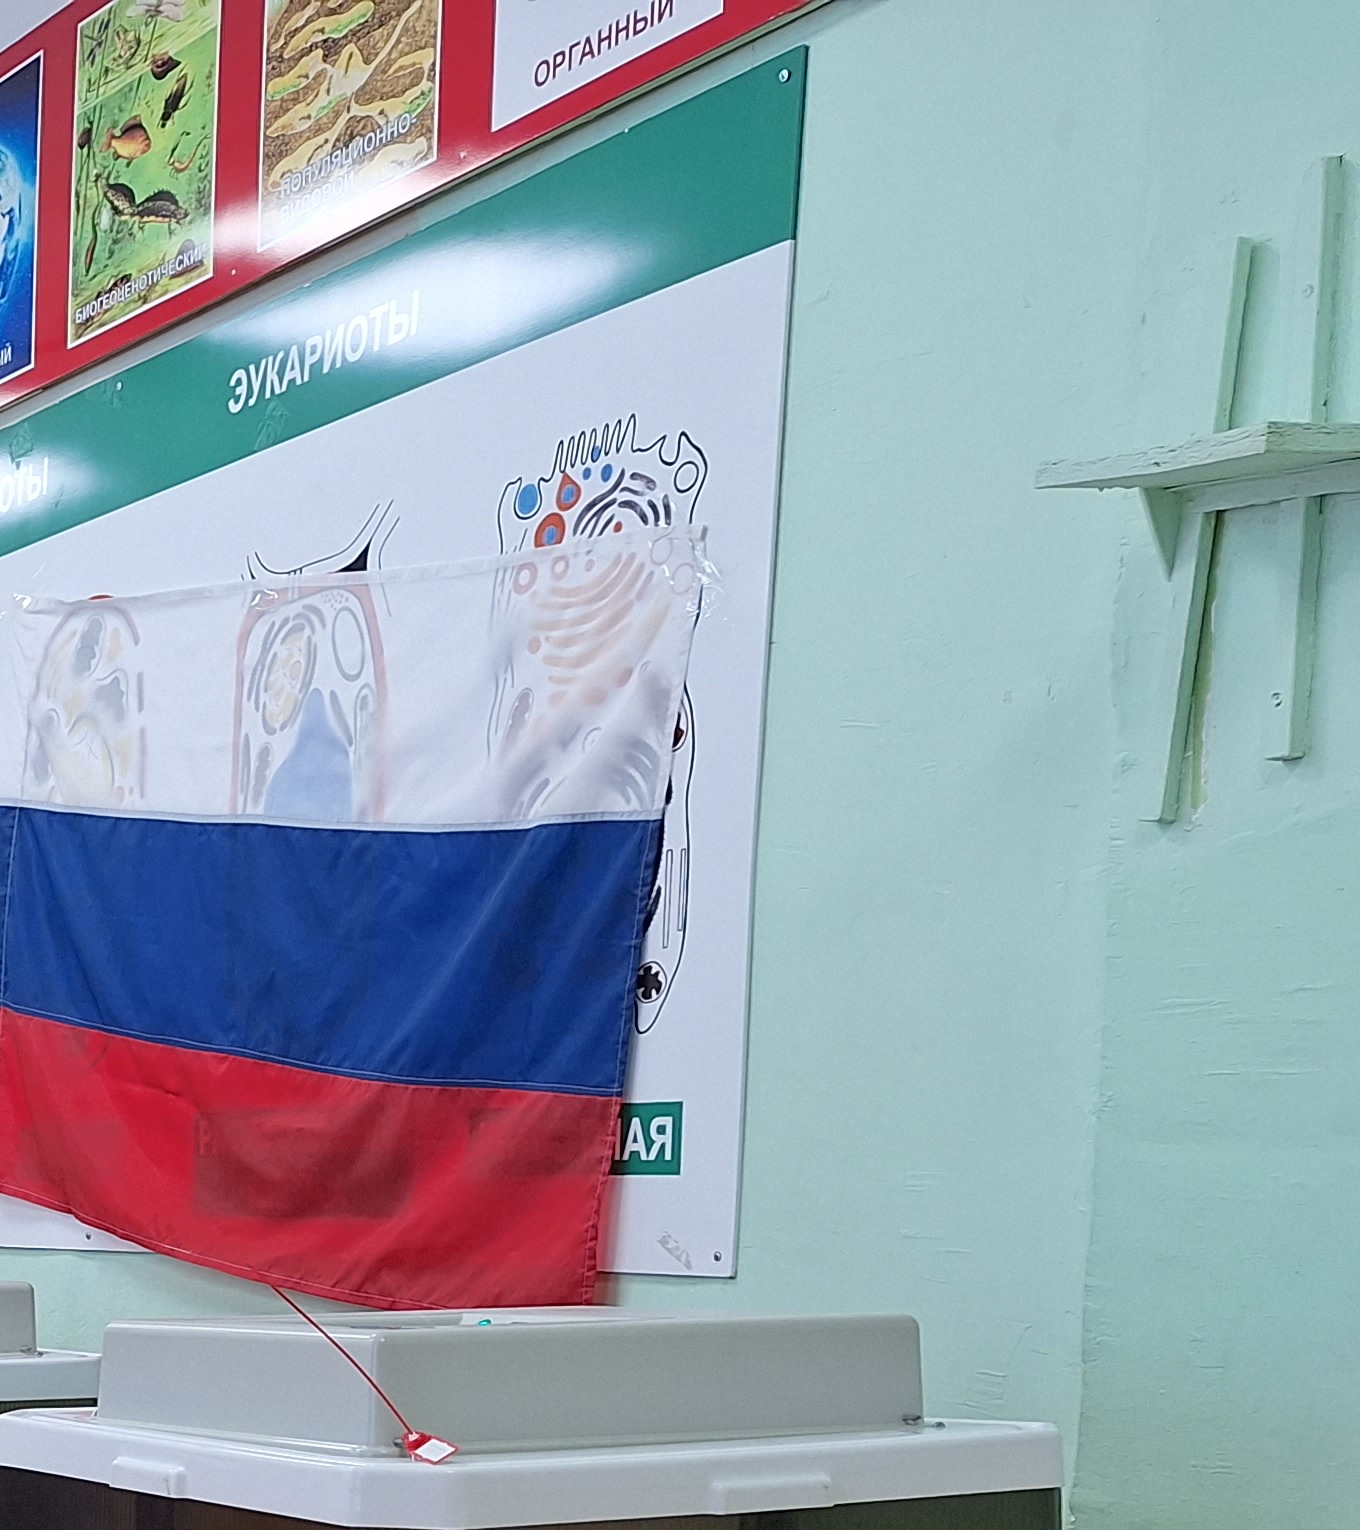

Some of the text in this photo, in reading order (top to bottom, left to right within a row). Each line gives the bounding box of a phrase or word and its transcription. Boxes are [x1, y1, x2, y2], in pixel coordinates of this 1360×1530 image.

[279, 112, 418, 199] ПОПУЛЯЦИОННО-
[75, 240, 207, 324] БИОГЕОЦЕНОТИЧЕСКИЙ
[227, 289, 421, 414] ЭУКАРИОТЫ
